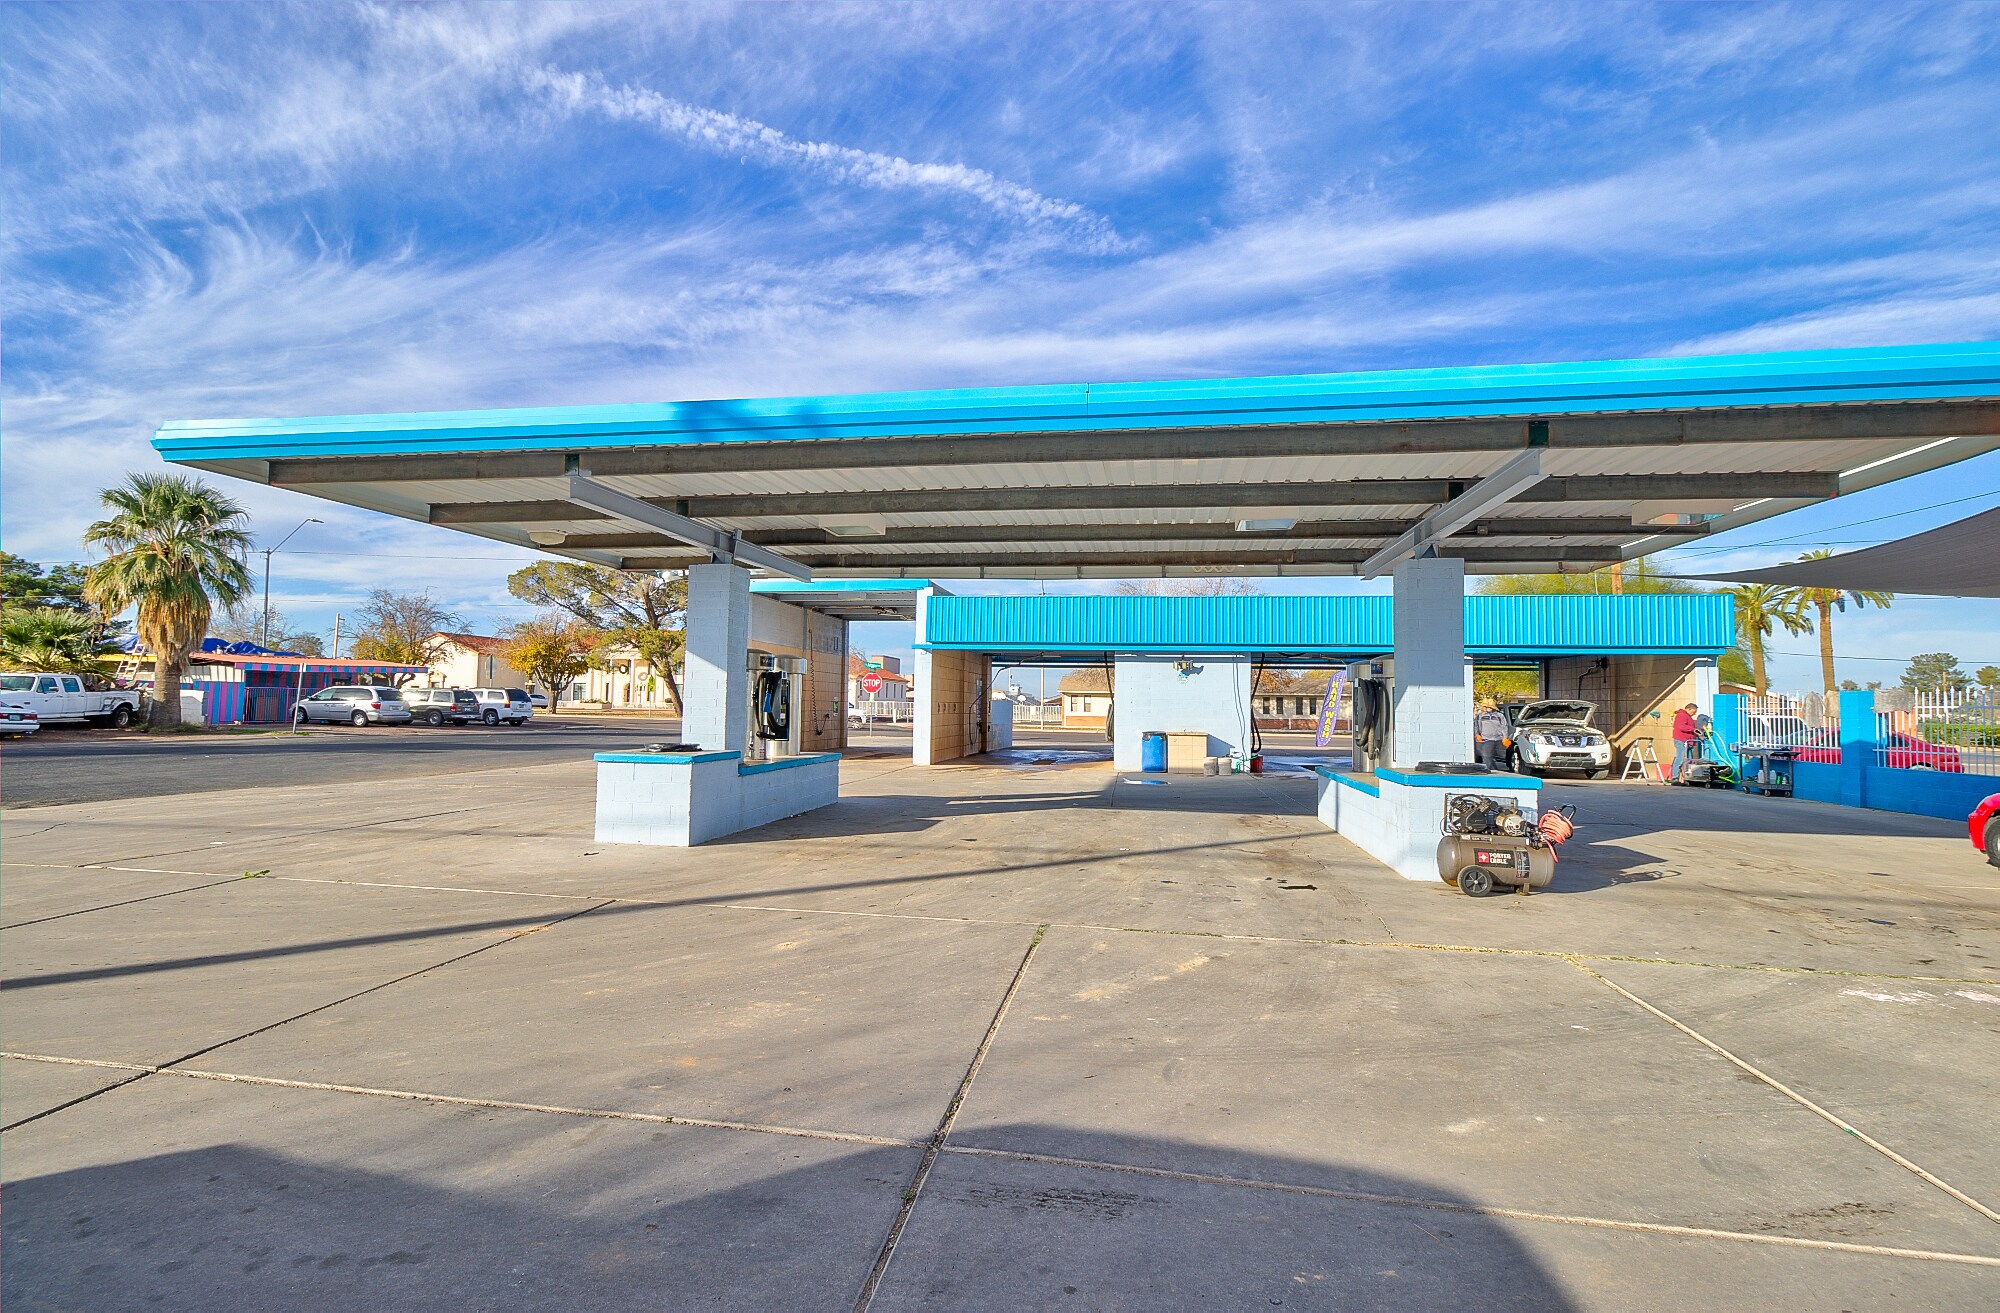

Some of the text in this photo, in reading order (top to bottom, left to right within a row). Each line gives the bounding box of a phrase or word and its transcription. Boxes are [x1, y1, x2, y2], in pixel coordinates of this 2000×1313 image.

[864, 679, 880, 687] STOP
[1322, 681, 1339, 738] HAND WASH
